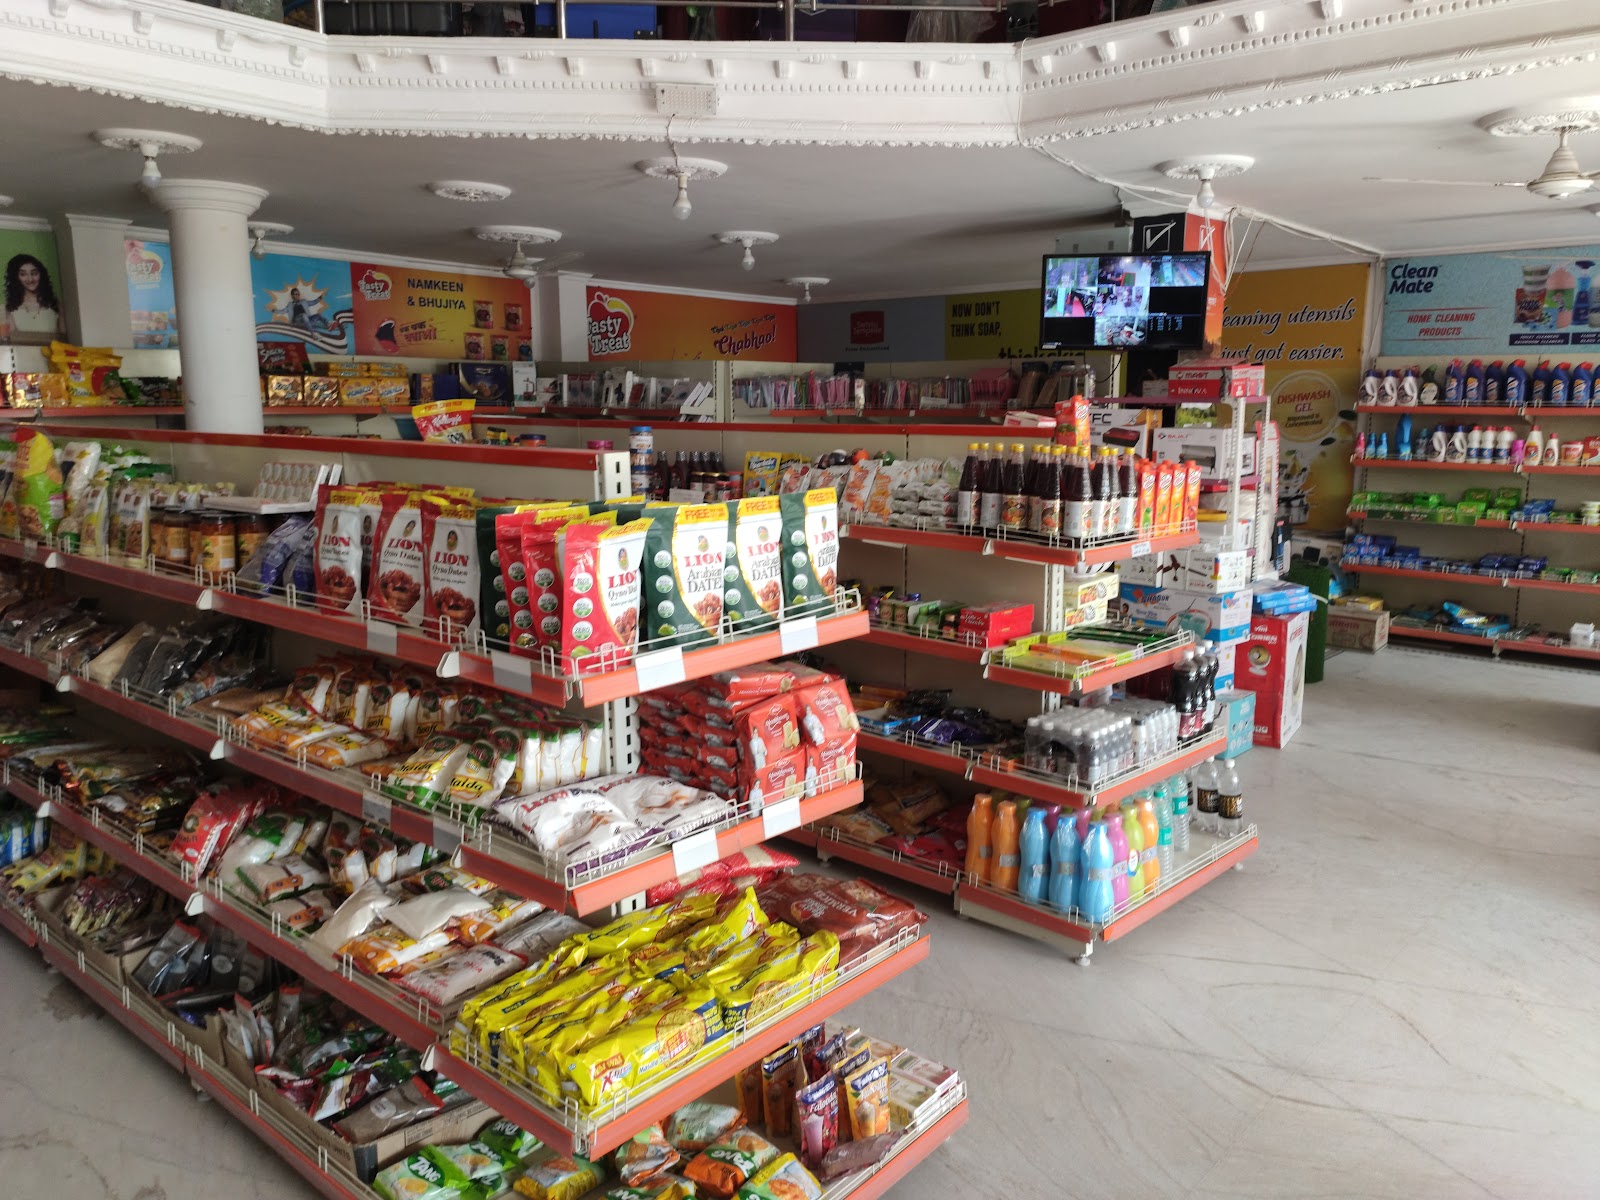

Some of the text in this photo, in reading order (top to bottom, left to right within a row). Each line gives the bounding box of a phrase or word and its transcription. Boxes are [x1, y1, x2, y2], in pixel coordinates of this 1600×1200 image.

[1391, 263, 1439, 279] Clean
[407, 278, 464, 292] NAMKEEN
[1388, 279, 1434, 295] Mate
[406, 296, 466, 310] & BHUJIYA
[952, 301, 1000, 318] NOW DON'T
[1287, 297, 1356, 324] utensils
[1407, 312, 1476, 324] HOME CLEANING
[951, 322, 975, 337] THINK
[1418, 327, 1462, 337] PRODUCTS
[591, 332, 630, 353] Treat
[714, 323, 777, 356] Chabhao!
[1254, 342, 1285, 361] got
[1288, 343, 1345, 361] easier.
[1277, 390, 1331, 405] DISHWASH
[1295, 402, 1313, 413] GEL
[684, 509, 711, 520] FREE
[388, 539, 423, 553] LION
[434, 551, 470, 567] LION
[409, 1156, 441, 1182] TANG
